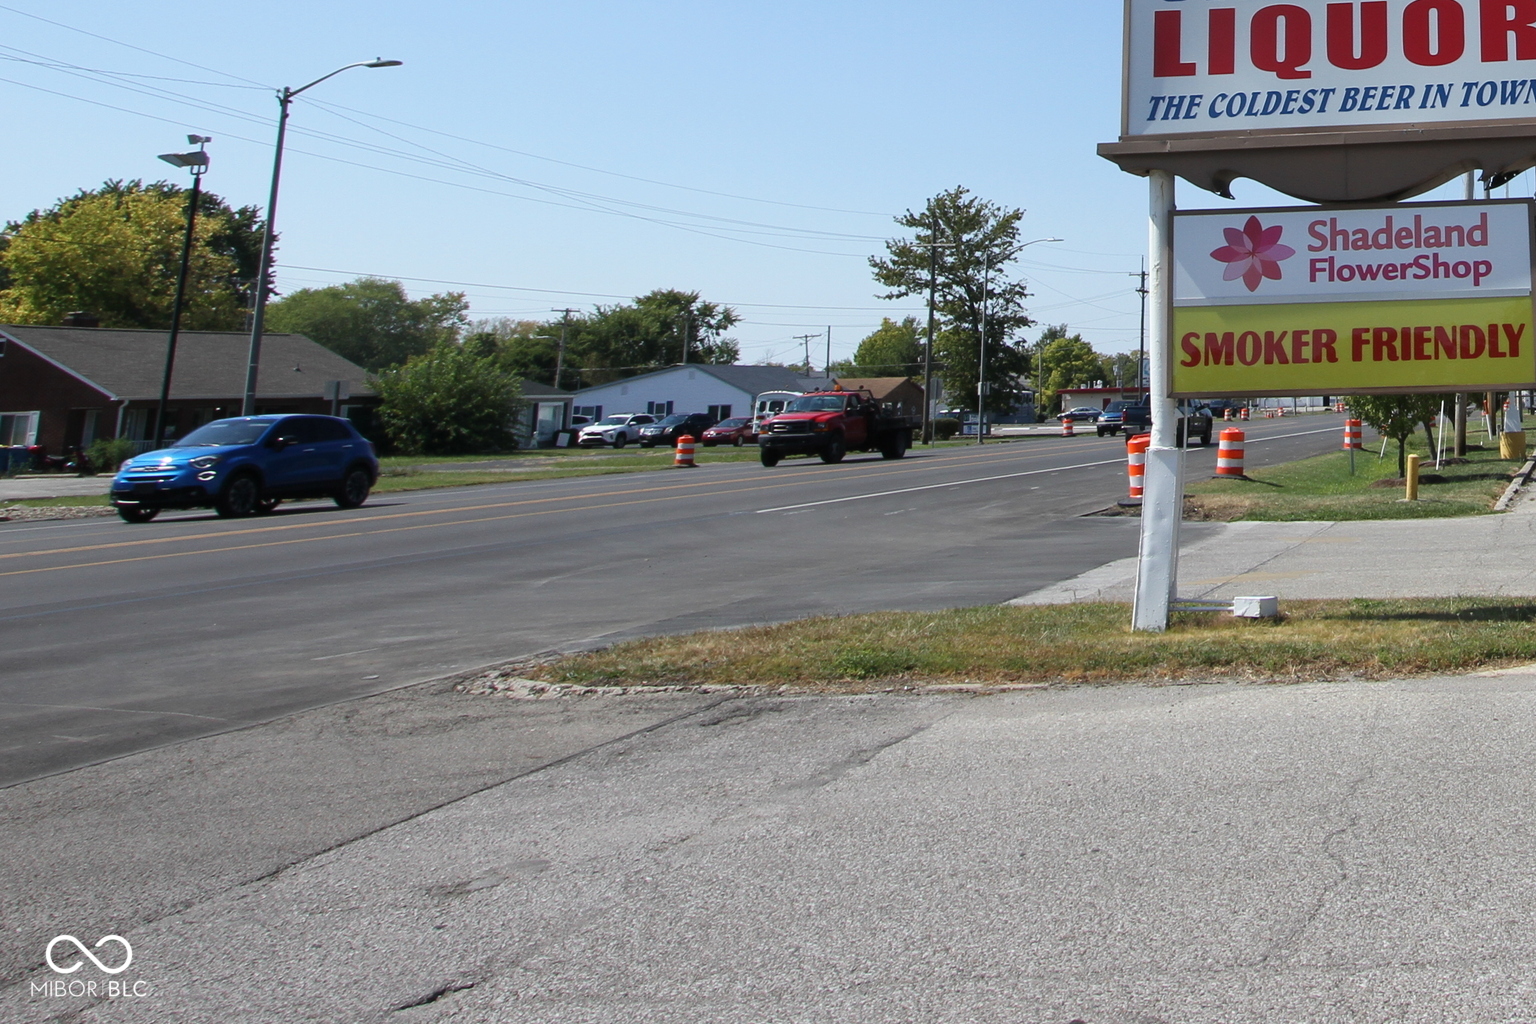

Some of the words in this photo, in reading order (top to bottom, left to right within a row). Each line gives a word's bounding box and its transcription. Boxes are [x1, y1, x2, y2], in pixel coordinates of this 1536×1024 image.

[1146, 93, 1204, 122] THE
[1207, 87, 1336, 119] COLDEST
[1338, 83, 1416, 113] BEER
[1418, 82, 1453, 110] IN
[1307, 212, 1489, 252] Shadeland
[1309, 252, 1493, 287] FlowerShop
[1180, 328, 1339, 367] SMOKER
[1351, 322, 1526, 362] FRIENDLY
